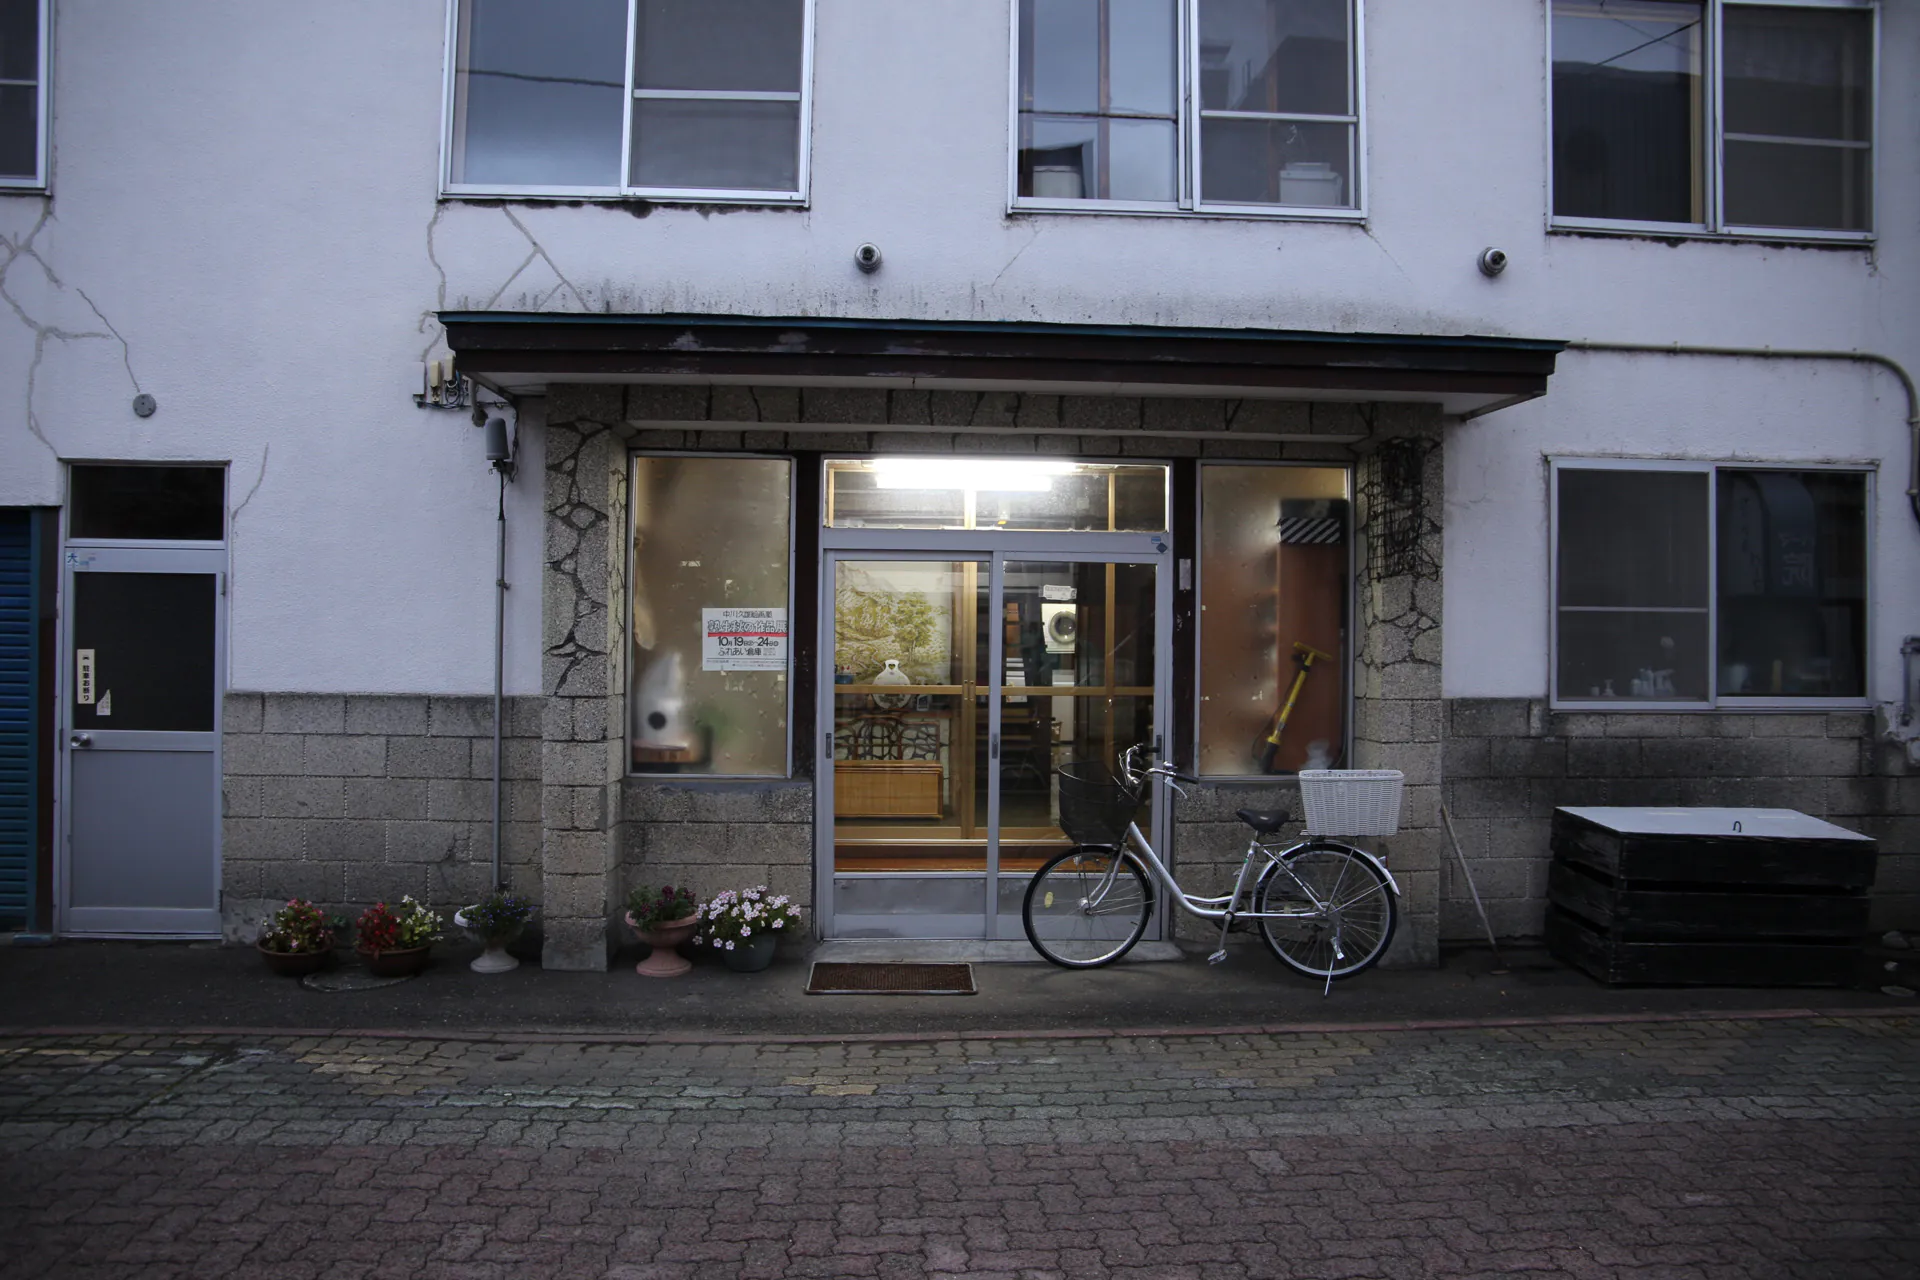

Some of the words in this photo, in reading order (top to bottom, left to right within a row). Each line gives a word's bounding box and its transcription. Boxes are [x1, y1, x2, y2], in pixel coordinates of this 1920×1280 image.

[707, 619, 788, 633] 塾生秋の作品展
[718, 647, 761, 656] ふれあい倉庫
[82, 665, 90, 701] 駐車お断り
